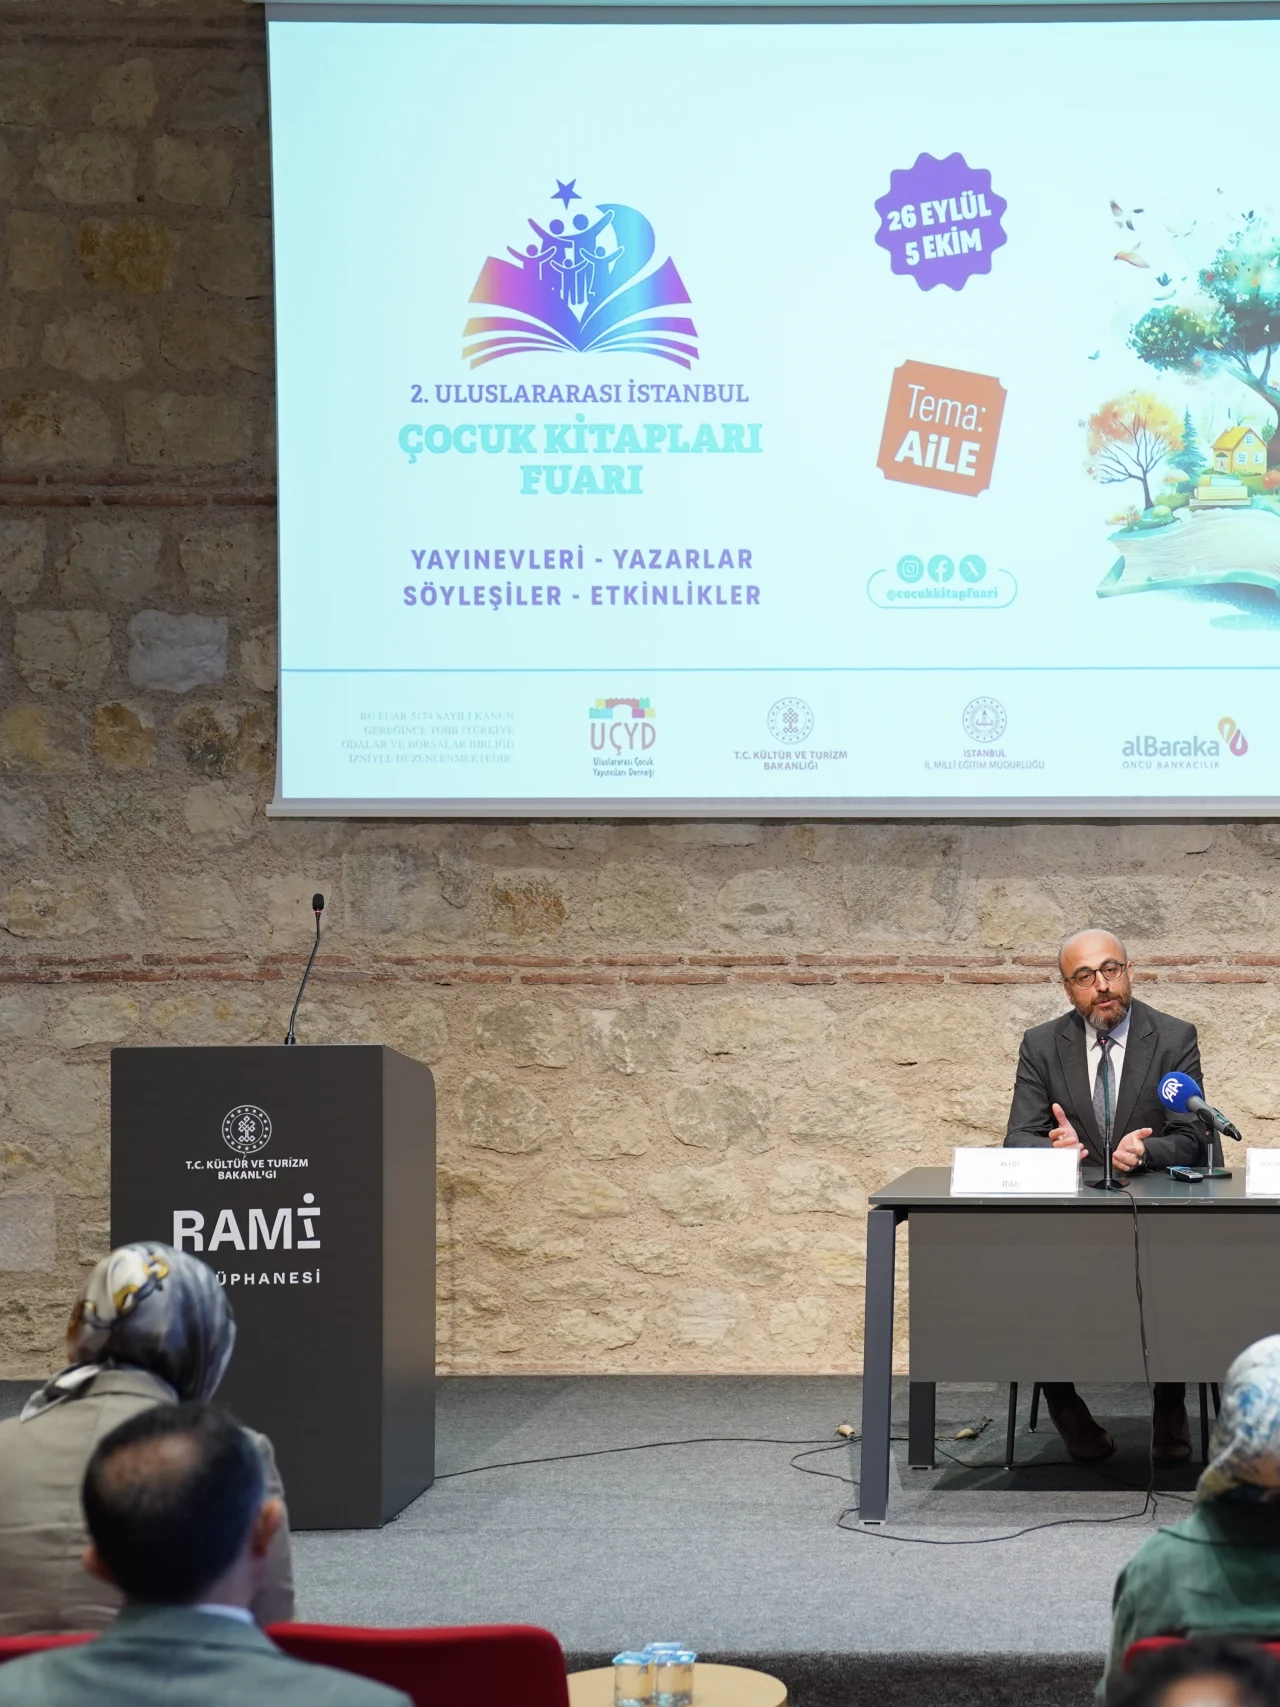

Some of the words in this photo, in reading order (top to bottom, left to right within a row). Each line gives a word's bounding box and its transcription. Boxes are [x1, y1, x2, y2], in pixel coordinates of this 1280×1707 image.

[887, 204, 917, 231] 26
[920, 190, 992, 226] EYLÜL
[905, 241, 920, 266] 5
[922, 225, 983, 259] EKİM
[410, 384, 428, 403] 2.
[435, 384, 622, 403] ULUSLARARASI
[628, 379, 749, 403] İSTANBUL
[908, 384, 987, 432] Tema:
[398, 423, 536, 464] ÇOCUK
[544, 413, 763, 454] KİTAPLARI
[519, 465, 643, 494] FUARI
[411, 544, 583, 570] YAYINEVLERİ
[612, 549, 753, 569] YAZARLAR
[403, 581, 561, 611] SÖYLEŞİLER
[591, 581, 761, 605] ETKİNLİKLER
[886, 587, 998, 601] @cocukkitapfuari
[378, 711, 407, 721] FUAR
[391, 739, 405, 749] VE
[591, 722, 656, 756] UÇYD
[1122, 736, 1220, 757] alBaraka
[634, 757, 654, 767] Çocuk
[734, 751, 751, 760] T.C.
[753, 749, 792, 760] KÜLTÜR
[794, 751, 807, 759] VE
[809, 749, 848, 759] TURİZM
[963, 748, 1006, 758] İSTANBUL
[628, 768, 655, 778] Derneği
[764, 760, 818, 770] BAKANLIĞI
[1157, 760, 1220, 769] BANKACILIK
[185, 1160, 204, 1170] T.C.
[206, 1158, 248, 1169] KÜLTÜR
[251, 1160, 264, 1168] VE
[267, 1157, 309, 1168] TURİZM
[173, 1192, 321, 1252] RAMİ
[215, 1268, 320, 1286] ÜPHANESİ
